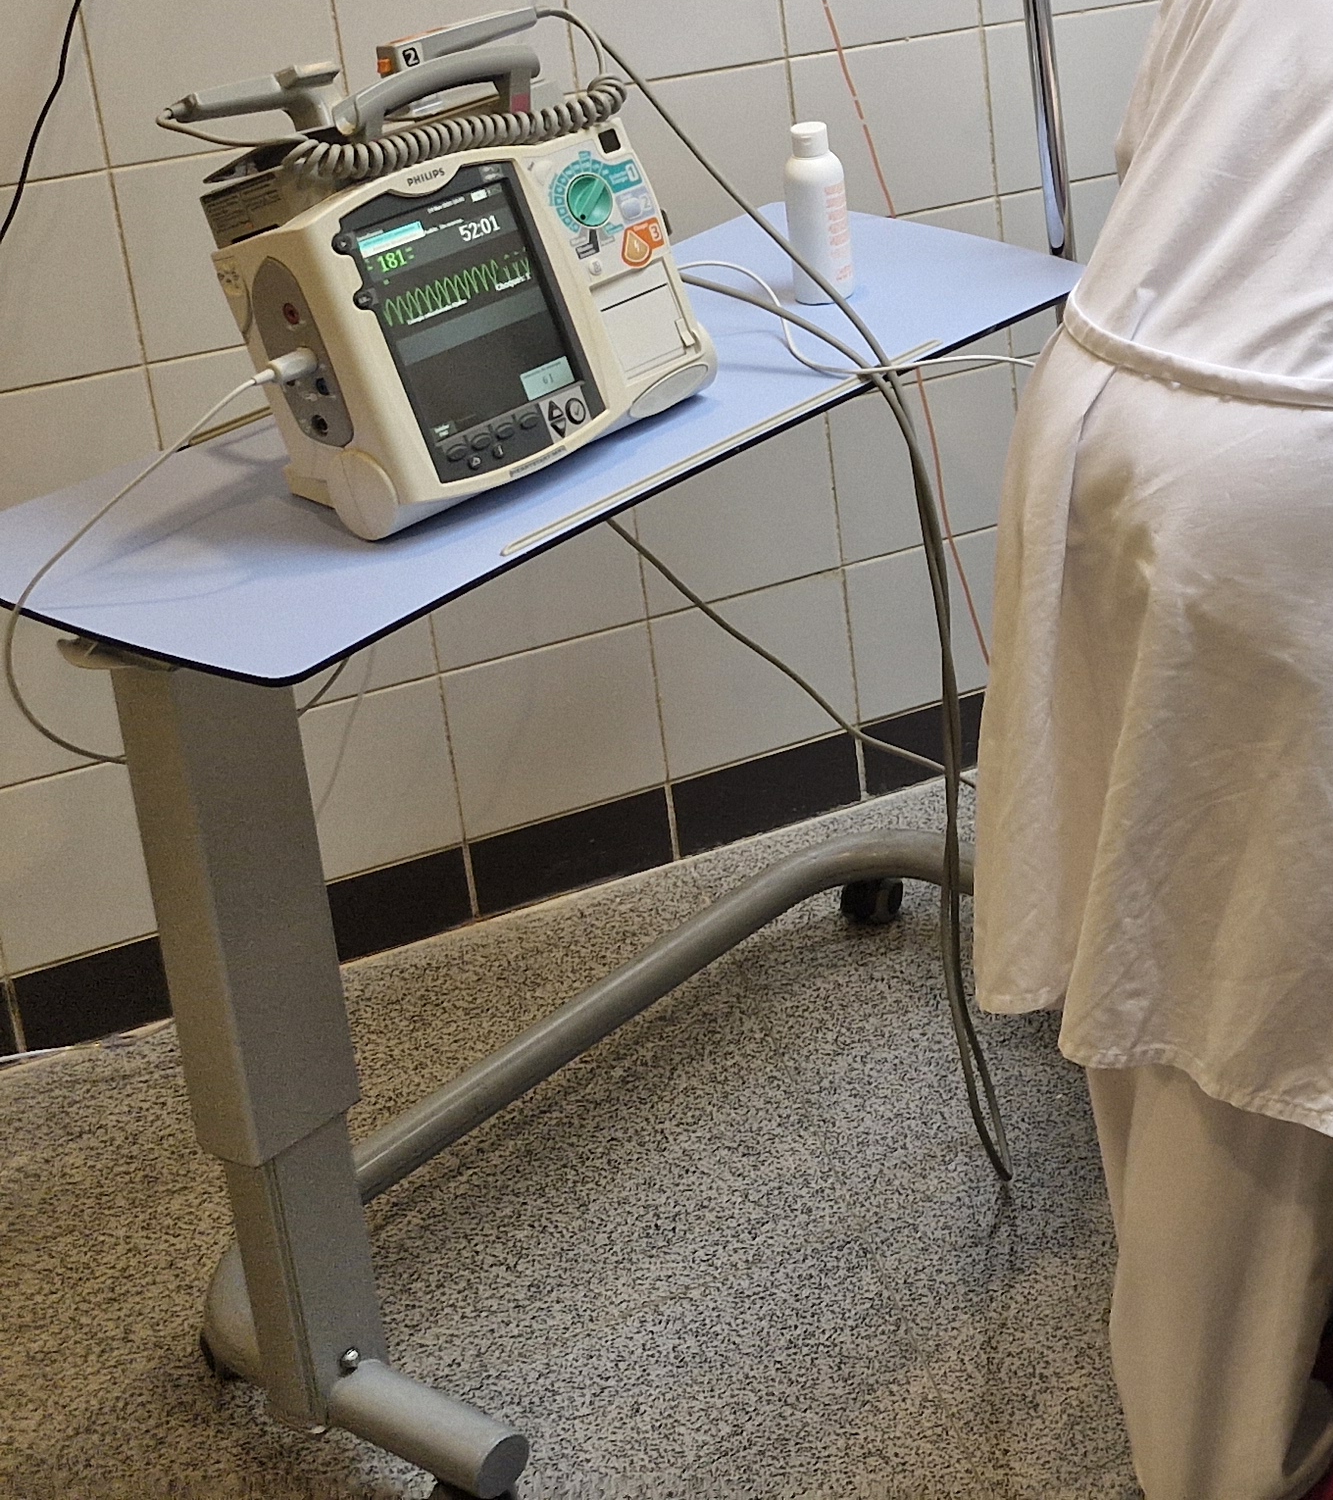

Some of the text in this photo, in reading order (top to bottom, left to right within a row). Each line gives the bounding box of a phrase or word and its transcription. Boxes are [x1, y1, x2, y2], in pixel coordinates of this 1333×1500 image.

[405, 49, 420, 66] 2
[406, 167, 446, 187] PHILIPS
[459, 214, 501, 242] 52:01
[650, 225, 661, 240] 3
[376, 249, 408, 273] 181
